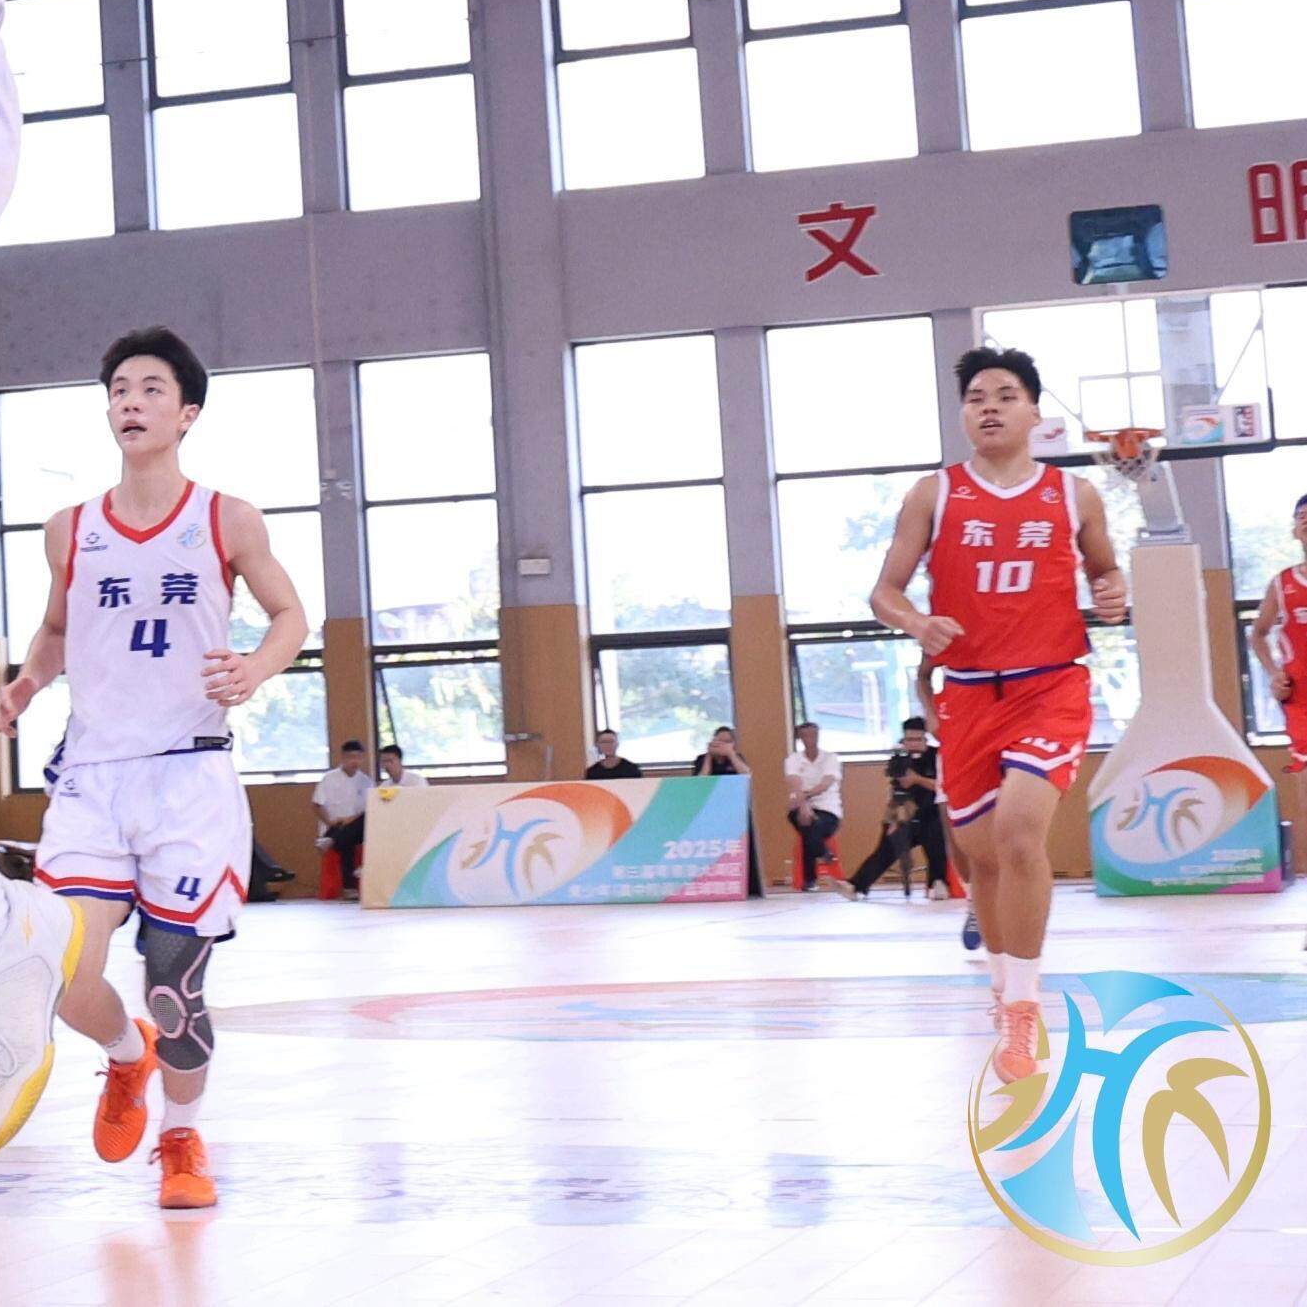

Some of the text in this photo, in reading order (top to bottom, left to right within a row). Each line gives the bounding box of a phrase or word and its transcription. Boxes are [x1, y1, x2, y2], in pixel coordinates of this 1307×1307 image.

[797, 201, 883, 283] 文
[960, 519, 1055, 549] 东莞
[97, 573, 199, 609] 东莞
[975, 560, 1034, 594] 10
[129, 618, 172, 659] 4
[173, 875, 202, 902] 4
